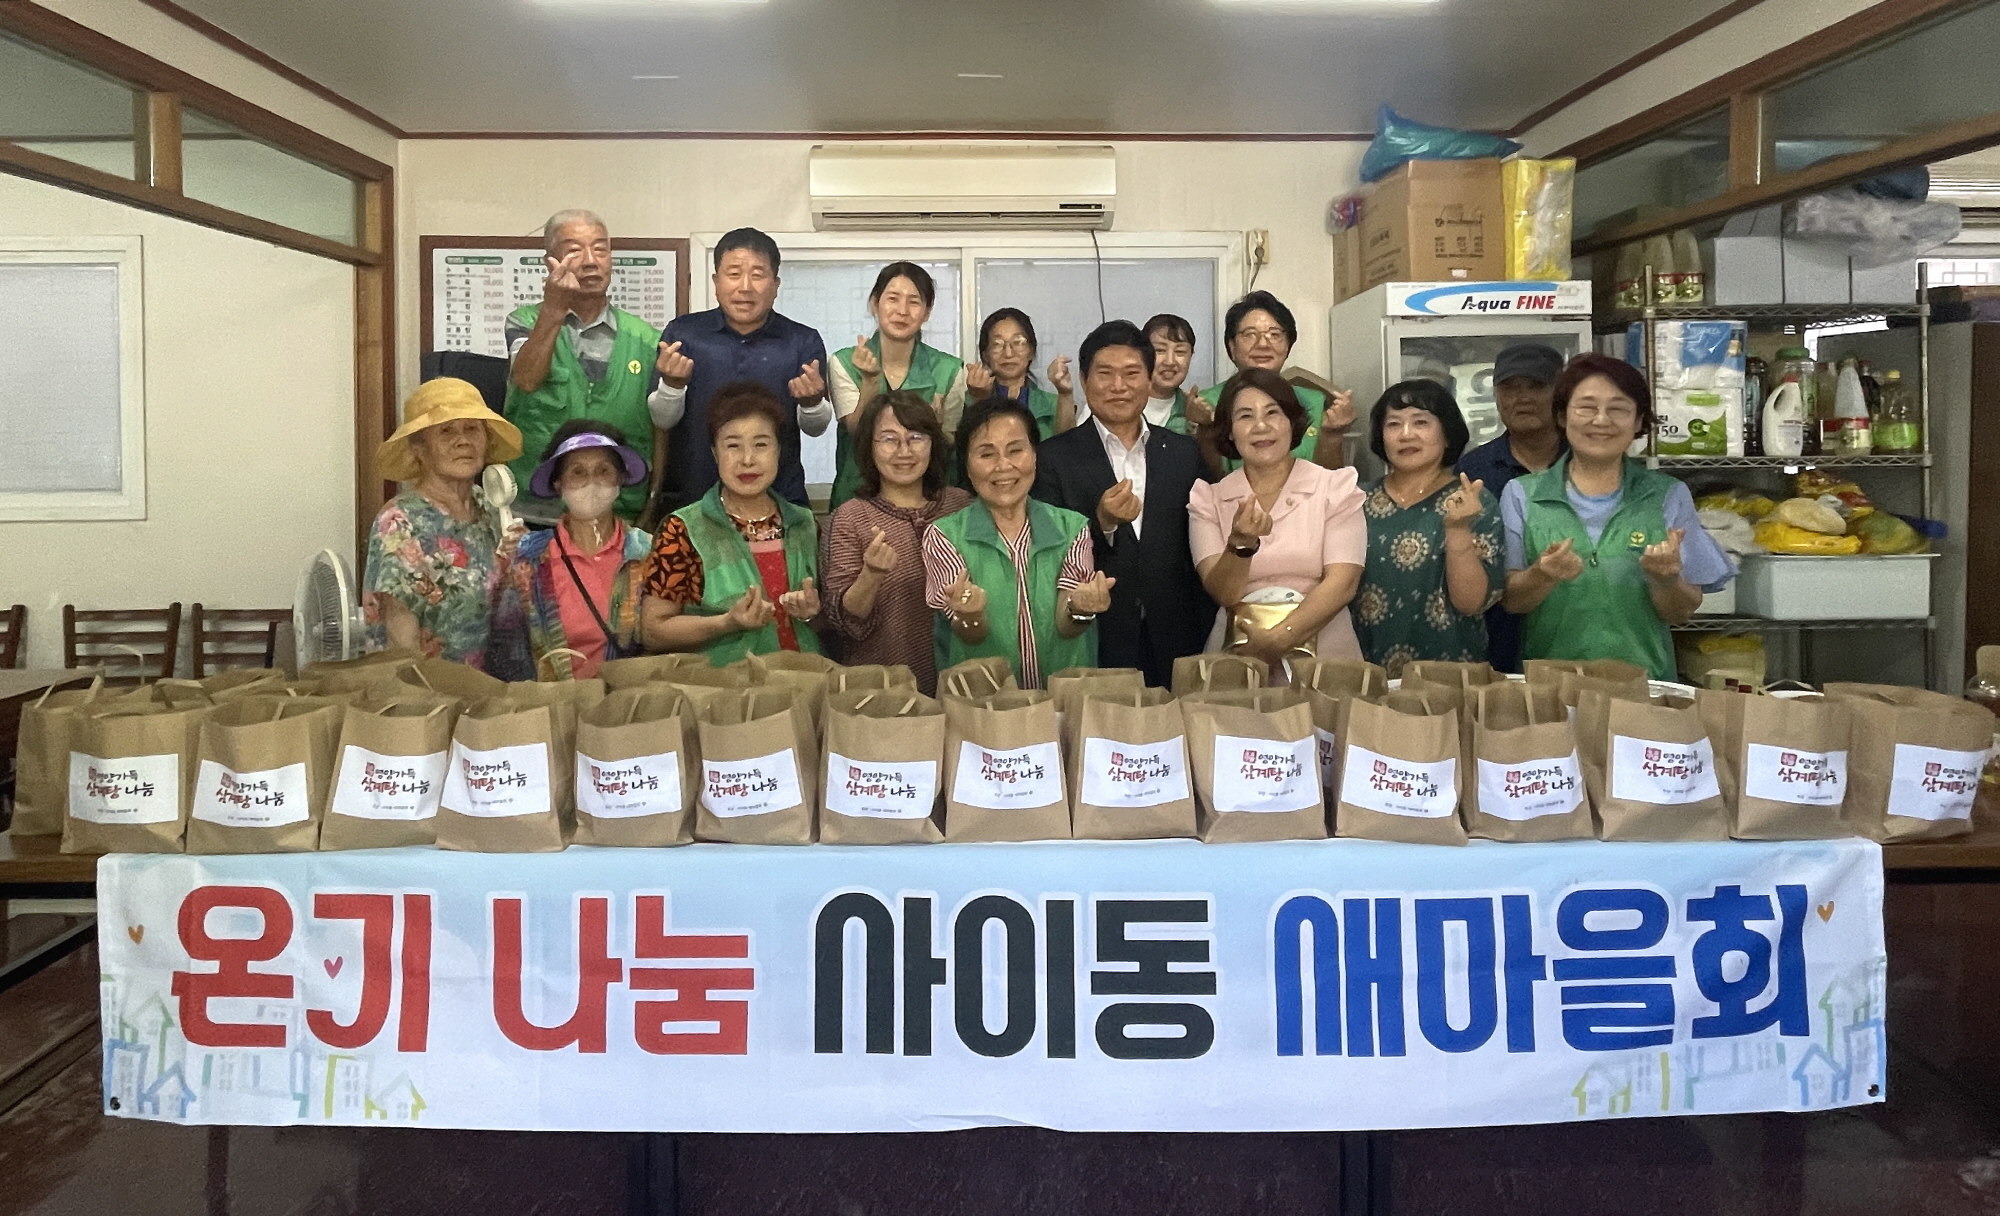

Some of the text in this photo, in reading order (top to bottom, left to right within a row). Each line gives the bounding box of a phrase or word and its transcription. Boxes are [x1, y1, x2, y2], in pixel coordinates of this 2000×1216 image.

[1460, 296, 1511, 312] Aqua
[1516, 295, 1556, 310] FINE
[499, 772, 528, 788] 나눔
[981, 764, 1044, 784] 삼계탕 나눔
[1108, 764, 1171, 783] 삼계탕 나눔
[1240, 764, 1284, 782] 삼계탕
[1642, 762, 1690, 780] 삼계탕
[125, 782, 154, 797] 나눔
[402, 780, 430, 794] 나눔
[632, 776, 658, 790] 나눔
[708, 778, 778, 798] 삼계탕 나눔
[846, 780, 916, 798] 삼계탕 나눔
[1369, 774, 1438, 798] 삼계탕 나눔
[1504, 776, 1575, 798] 삼계탕 나눔
[256, 792, 284, 806] 나눔
[172, 885, 1809, 1059] 온기 나눔 사이동 새마을회
